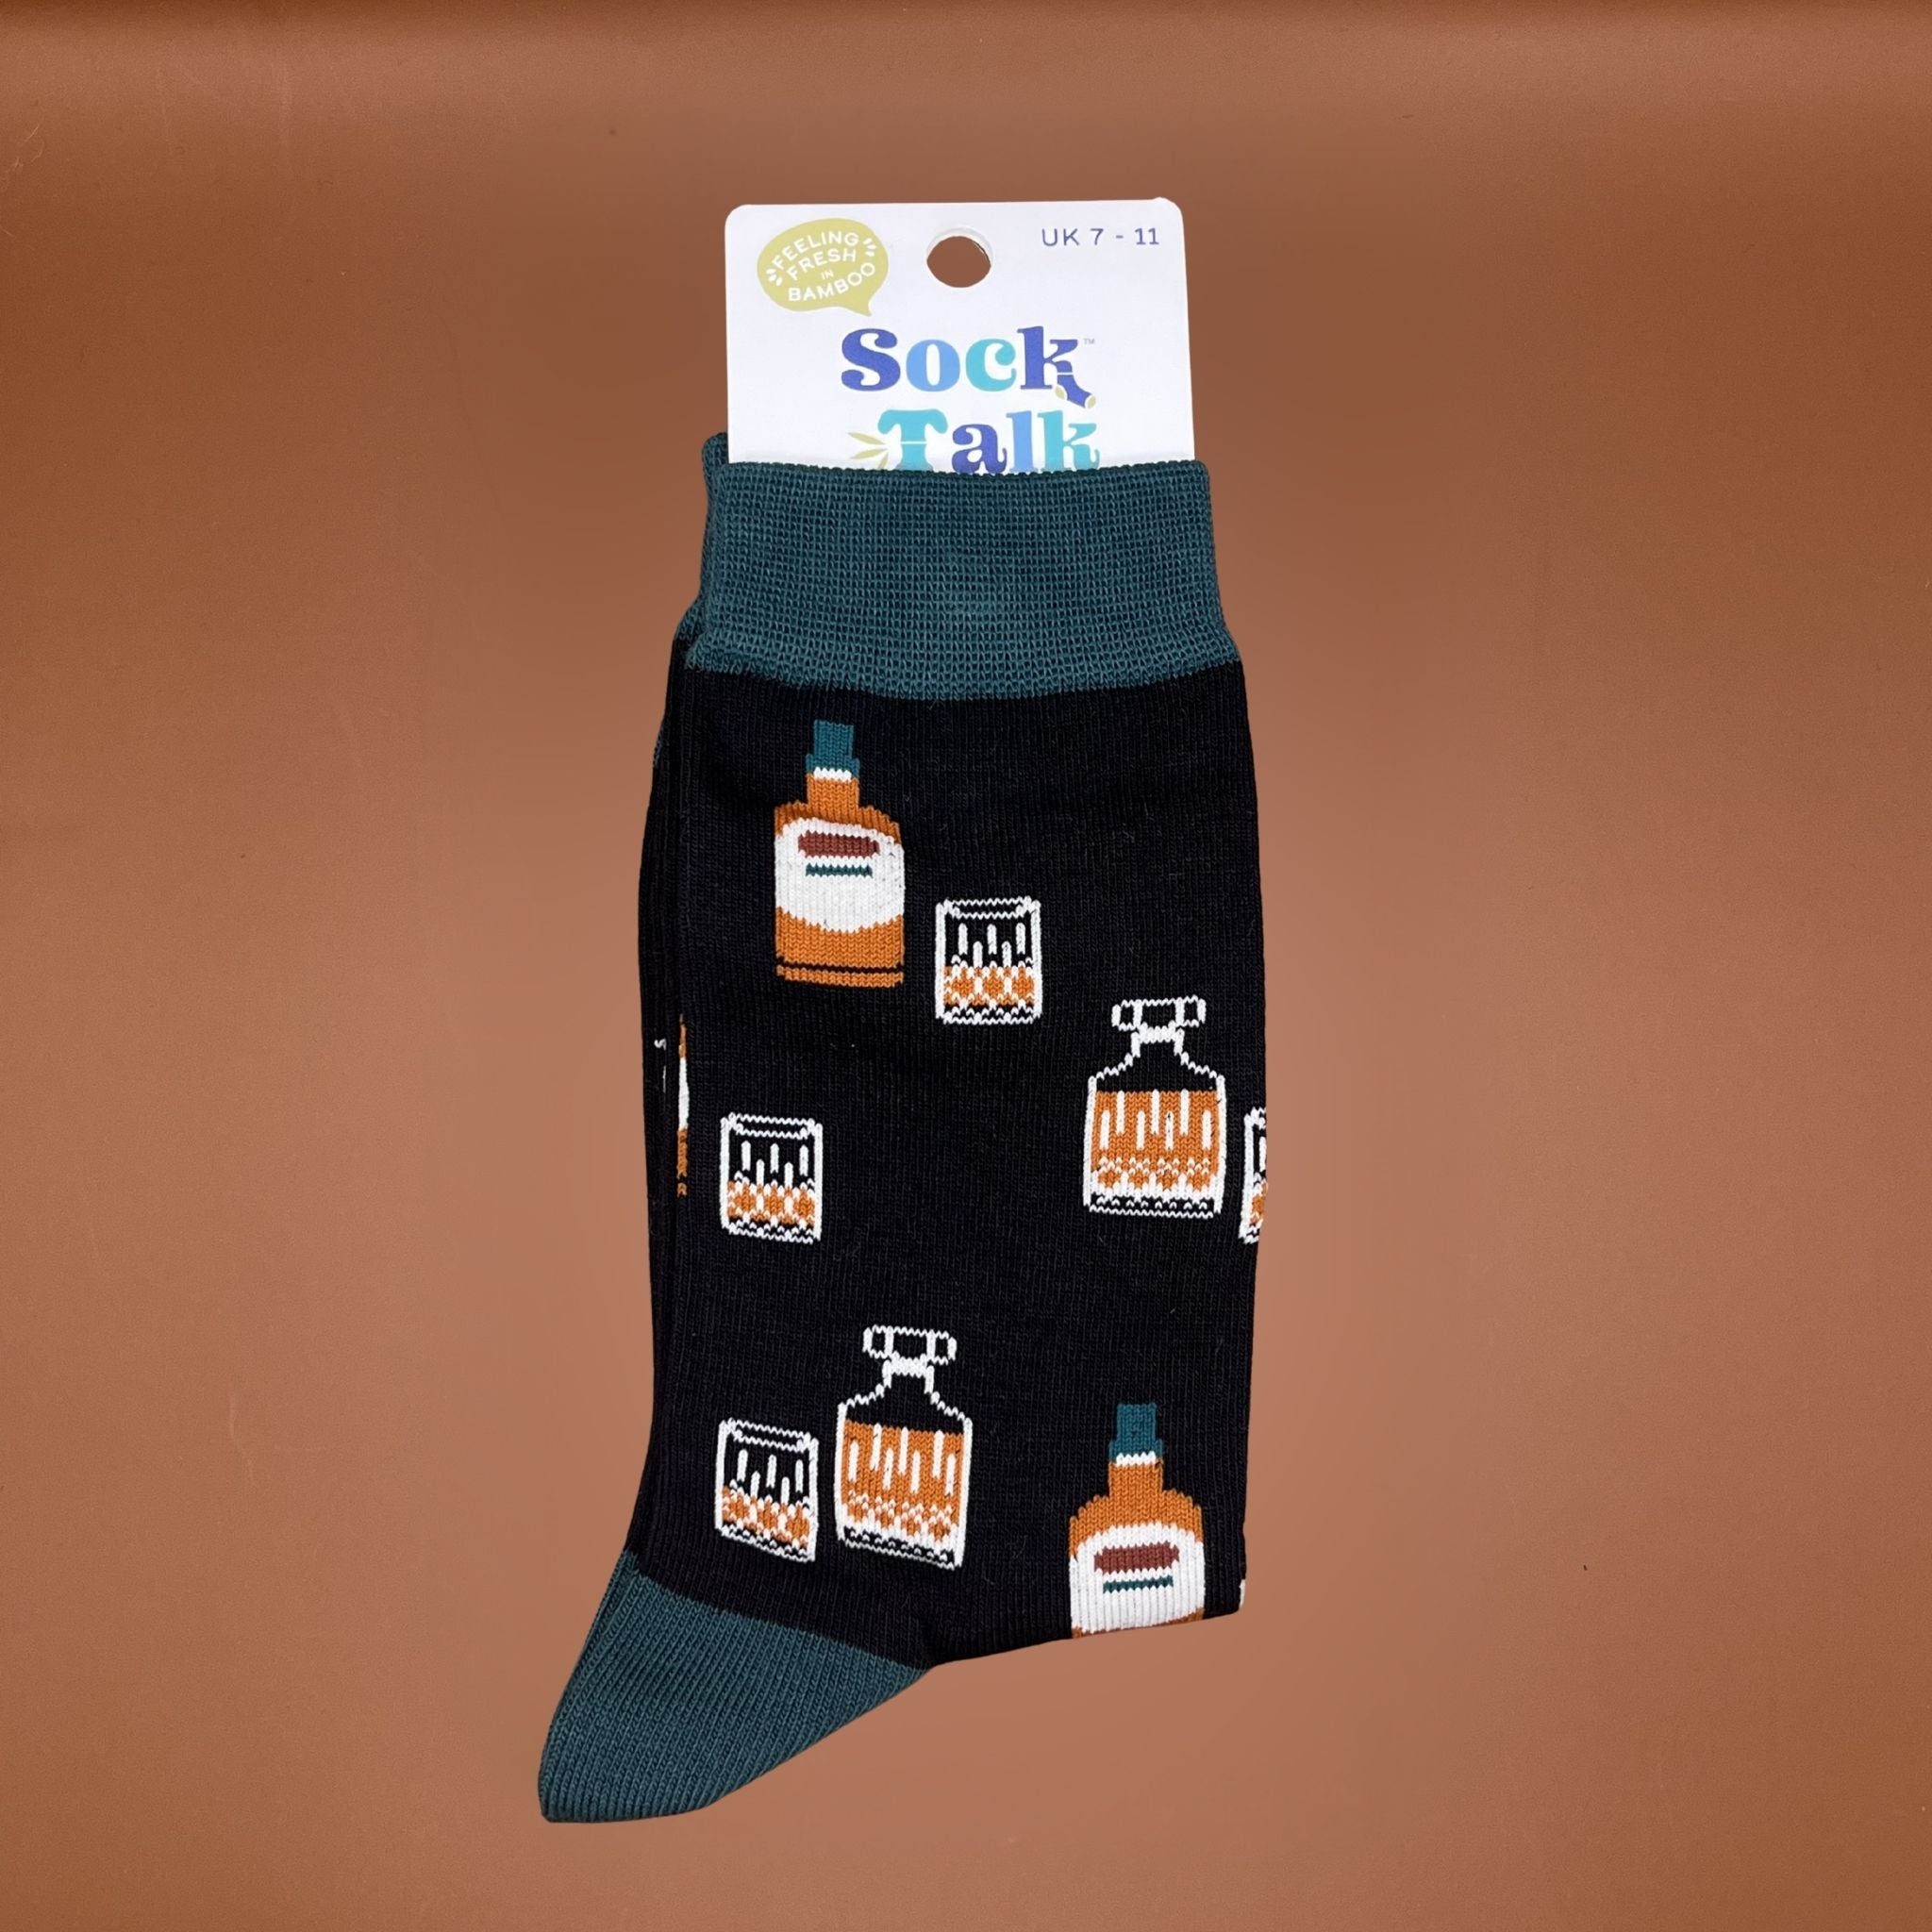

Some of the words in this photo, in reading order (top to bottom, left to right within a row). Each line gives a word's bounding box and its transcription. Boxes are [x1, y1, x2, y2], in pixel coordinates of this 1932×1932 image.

[772, 230, 859, 270] FEELING
[1041, 227, 1080, 246] UK
[1090, 227, 1105, 246] 7
[1134, 227, 1160, 245] 11
[786, 248, 858, 281] FRESH
[788, 262, 875, 301] BAMBOO
[821, 269, 834, 280] IN
[841, 325, 1096, 408] Sock
[877, 408, 1100, 473] Talk
